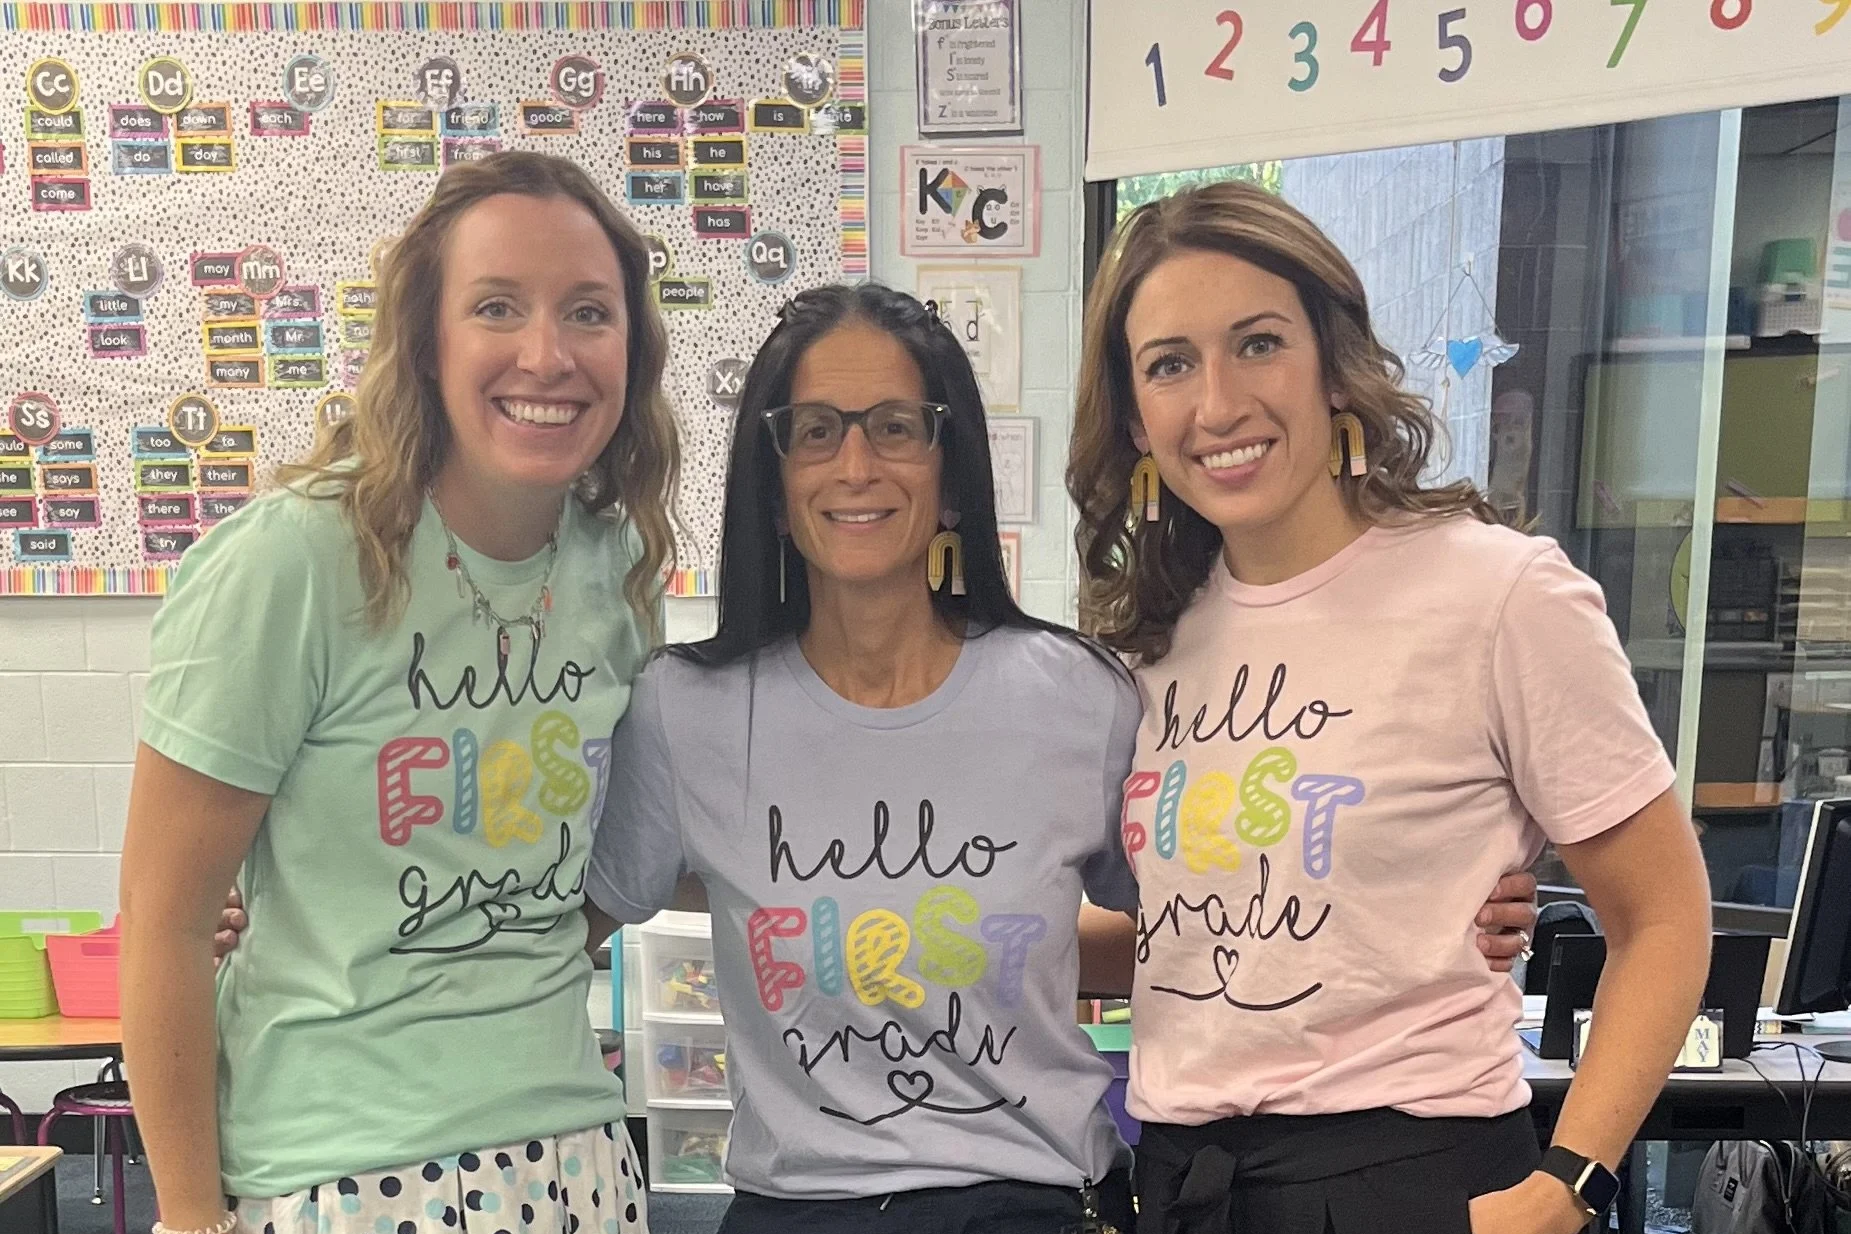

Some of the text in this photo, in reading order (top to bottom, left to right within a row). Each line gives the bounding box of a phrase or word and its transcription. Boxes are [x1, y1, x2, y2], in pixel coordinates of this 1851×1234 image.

[1145, 42, 1167, 107] 1
[1204, 10, 1243, 81] 2
[1288, 21, 1319, 92] 3
[1351, 0, 1391, 66] 4
[1438, 8, 1472, 82] 5
[1606, 0, 1648, 68] 7
[36, 71, 70, 97] Cc
[149, 70, 184, 96] Dd
[294, 66, 325, 93] Ee
[559, 66, 595, 97] Gg
[37, 114, 73, 127] could
[120, 112, 152, 127] does
[530, 111, 563, 124] good
[636, 112, 666, 123] here
[699, 111, 725, 123] how
[773, 111, 784, 122] is
[36, 151, 74, 164] called
[133, 152, 151, 163] do
[194, 148, 219, 161] day
[642, 146, 662, 159] his
[709, 146, 727, 158] he
[644, 181, 666, 194] her
[703, 180, 734, 192] have
[919, 168, 950, 215] K
[40, 187, 76, 200] come
[707, 216, 731, 228] has
[751, 241, 787, 269] Qq
[127, 255, 149, 282] Ll
[648, 249, 667, 276] p
[8, 257, 41, 283] Kk
[203, 263, 230, 276] may
[242, 259, 281, 280] Mm
[662, 285, 705, 299] people
[100, 299, 128, 313] little
[219, 300, 237, 312] my
[101, 334, 128, 347] look
[213, 334, 252, 344] month
[216, 367, 250, 379] many
[289, 365, 308, 376] me
[21, 403, 50, 429] Ss
[182, 406, 207, 431] Tt
[0, 440, 25, 452] ould
[50, 441, 84, 452] some
[150, 436, 171, 448] too
[222, 435, 236, 447] to
[0, 472, 18, 483] he
[52, 473, 80, 485] says
[150, 469, 178, 481] they
[207, 468, 237, 482] their
[59, 507, 80, 519] say
[148, 502, 181, 515] there
[214, 503, 235, 515] the
[30, 539, 57, 551] said
[159, 536, 177, 549] try
[408, 631, 595, 710] hello
[1155, 663, 1353, 752] hello
[377, 709, 612, 849] FIRST
[1121, 746, 1366, 880] FIRST
[769, 799, 1018, 883] hello
[747, 884, 1047, 1013] FIRST
[1695, 1028, 1710, 1063] MAY
